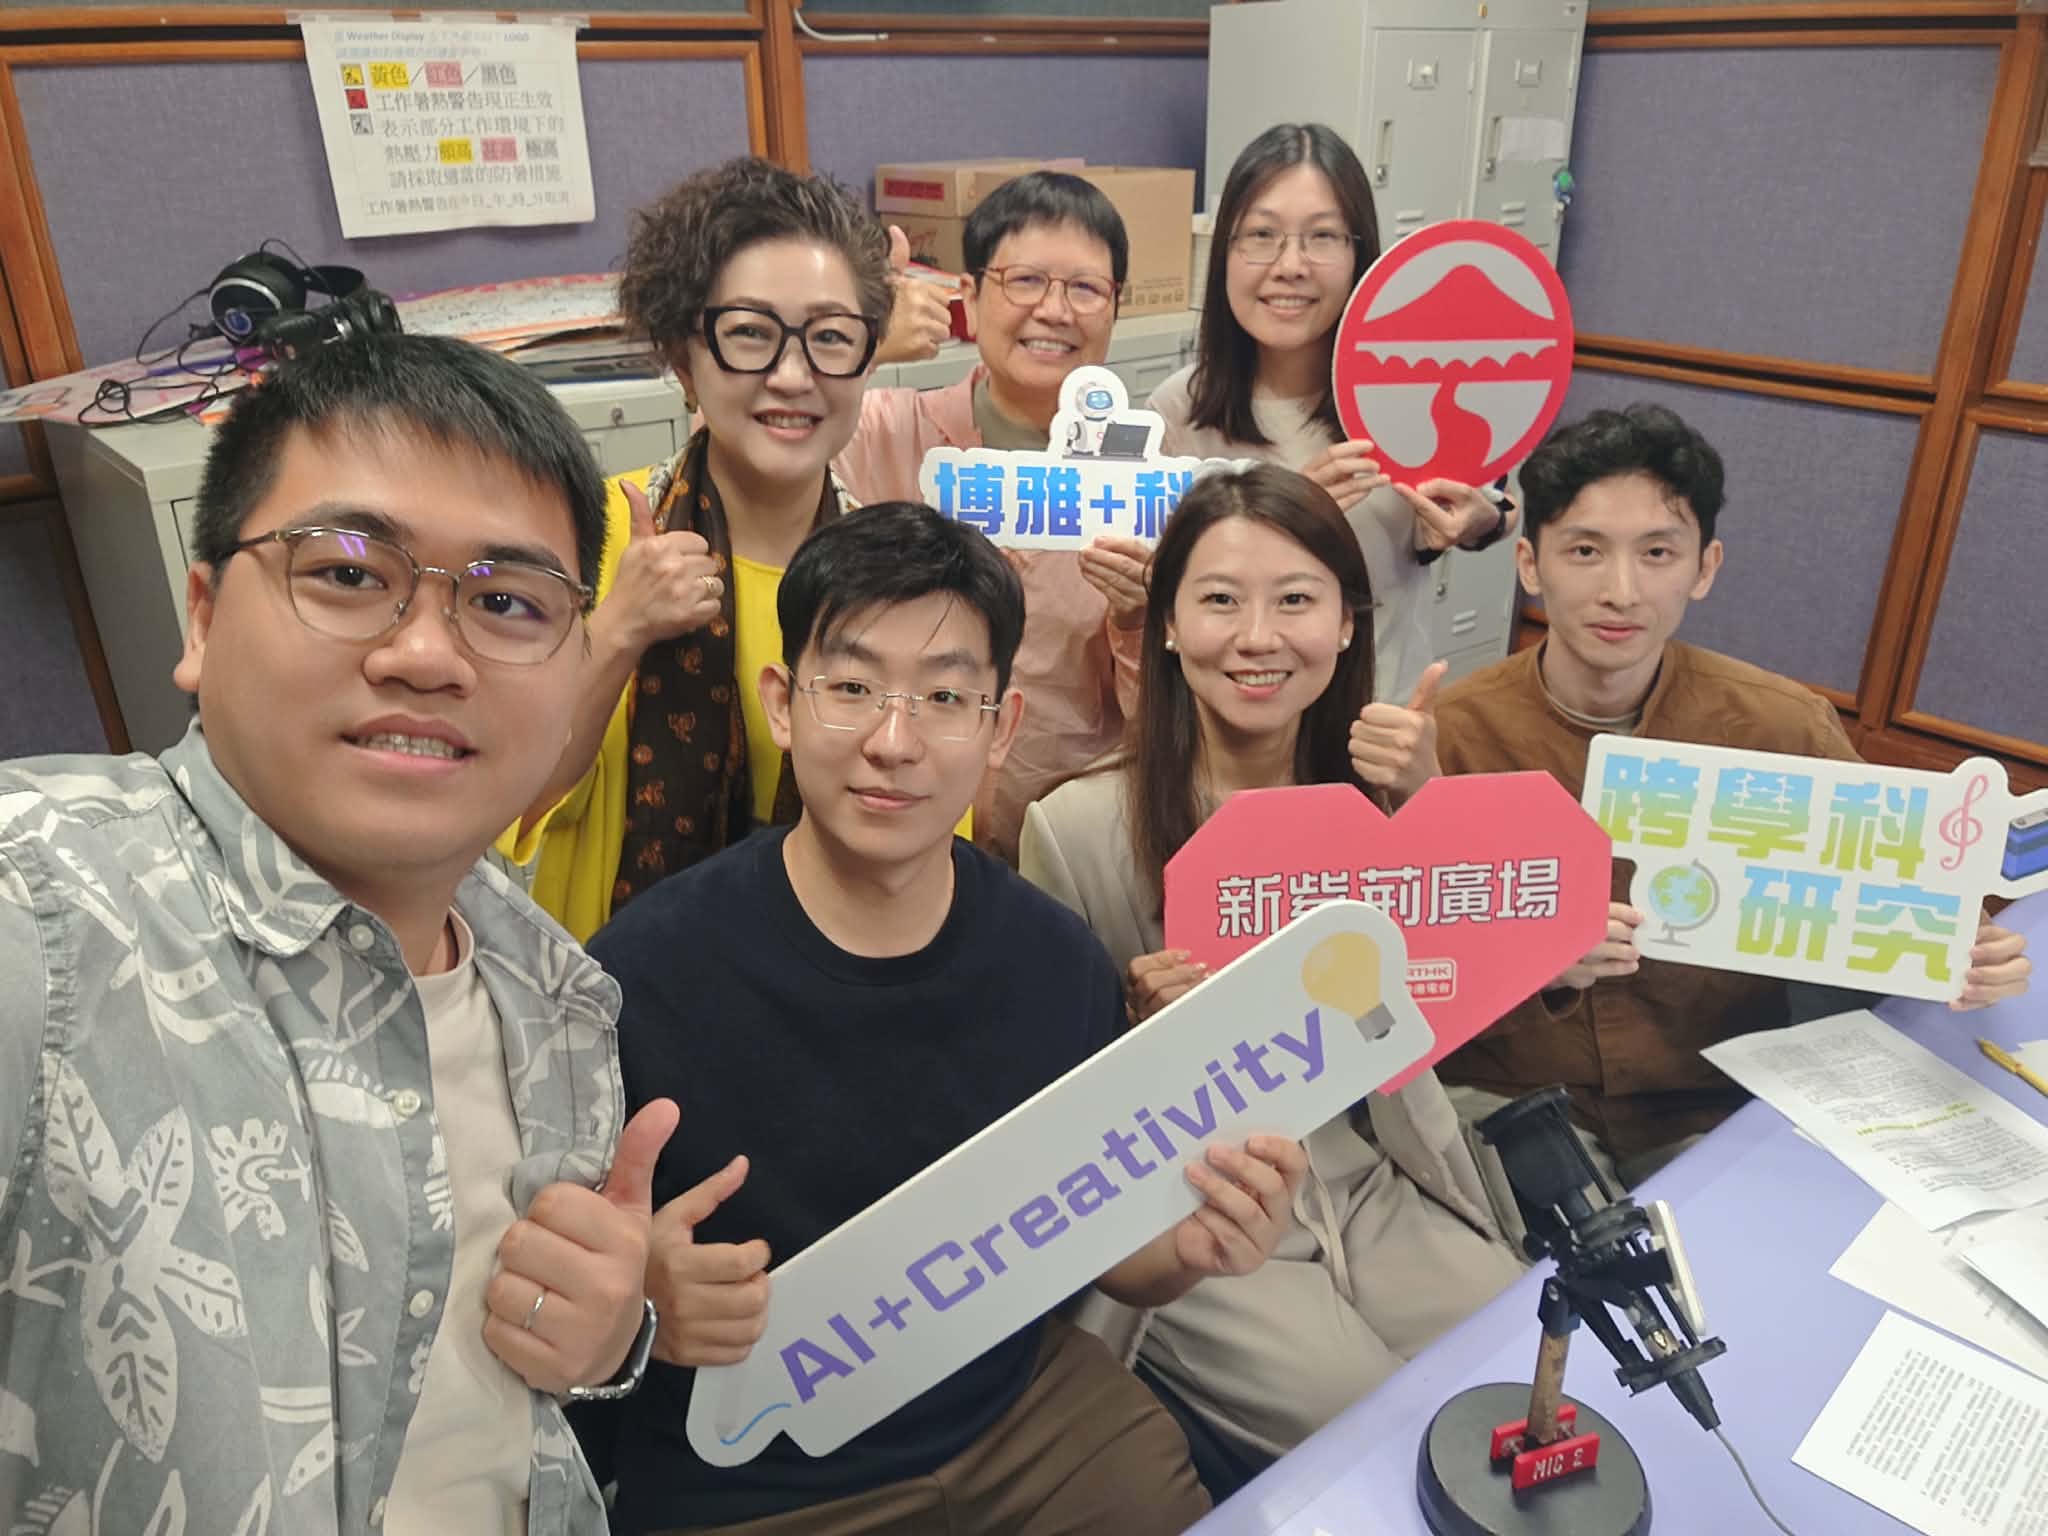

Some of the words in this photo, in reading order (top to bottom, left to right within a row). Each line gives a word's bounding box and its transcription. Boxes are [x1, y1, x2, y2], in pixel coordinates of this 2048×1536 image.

[347, 31, 389, 41] Weather
[392, 31, 425, 43] Display
[1600, 753, 1930, 880] 跨學科
[1735, 865, 1962, 983] 研究
[778, 1007, 1327, 1404] AI+Creativity
[1532, 1453, 1565, 1481] MIC
[1573, 1447, 1584, 1468] 2
